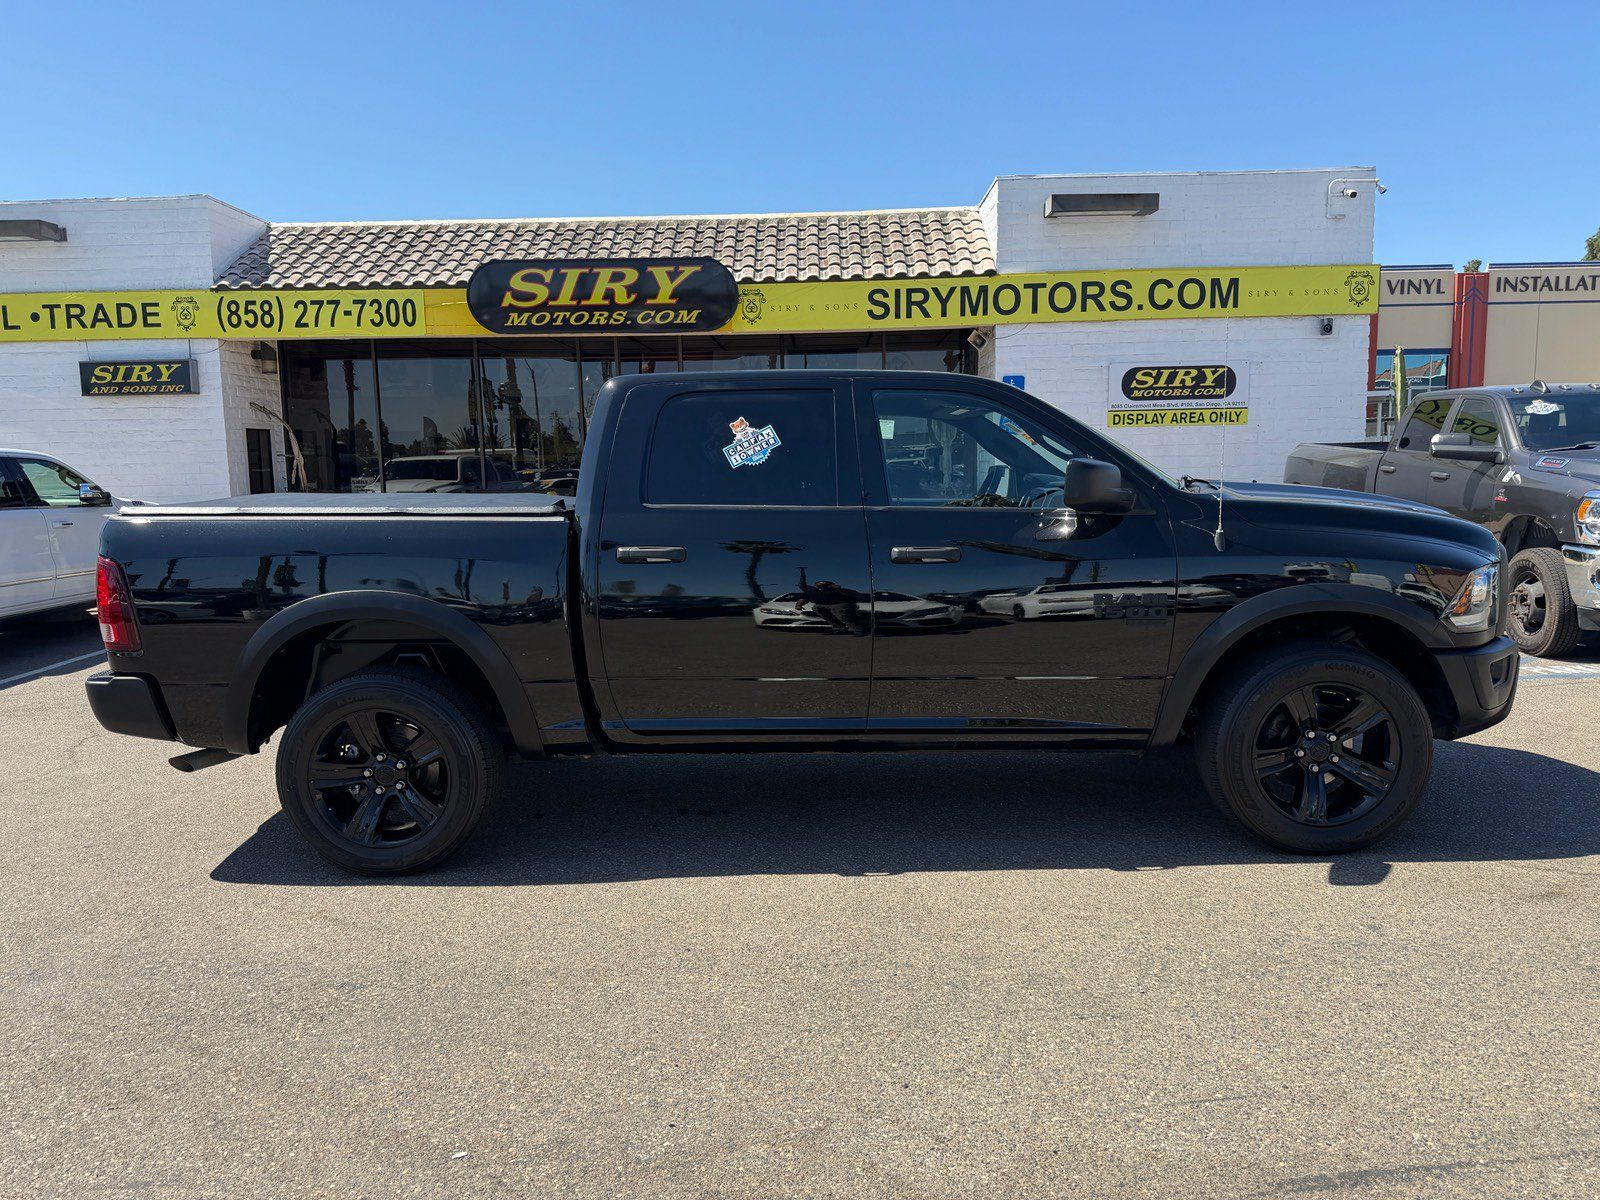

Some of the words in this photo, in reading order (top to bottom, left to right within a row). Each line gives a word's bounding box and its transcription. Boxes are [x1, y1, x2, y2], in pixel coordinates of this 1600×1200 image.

[501, 265, 702, 308] SIRY
[1386, 278, 1446, 296] VINYL
[1496, 274, 1600, 293] INSTALLAT
[867, 277, 1239, 321] SIRYMOTORS.COM
[1248, 289, 1279, 298] SIRY
[1288, 289, 1295, 297] &
[1304, 288, 1339, 296] SONS
[216, 296, 283, 333] (858)
[294, 297, 417, 329] 277-7300
[770, 303, 800, 313] SIRY
[809, 304, 816, 312] &
[825, 302, 859, 311] SONS
[504, 309, 702, 327] MOTORS.COM
[91, 364, 181, 384] SIRY
[1131, 368, 1227, 388] SIRY
[90, 386, 118, 394] AND
[122, 385, 157, 393] SONS
[160, 384, 184, 392] INC
[1131, 387, 1226, 398] MOTORS.COM
[1112, 412, 1167, 426] DISPLAY
[1170, 411, 1205, 424] AREA
[1209, 410, 1242, 423] ONLY
[728, 430, 772, 455] CARFAX
[1093, 593, 1168, 606] RAM
